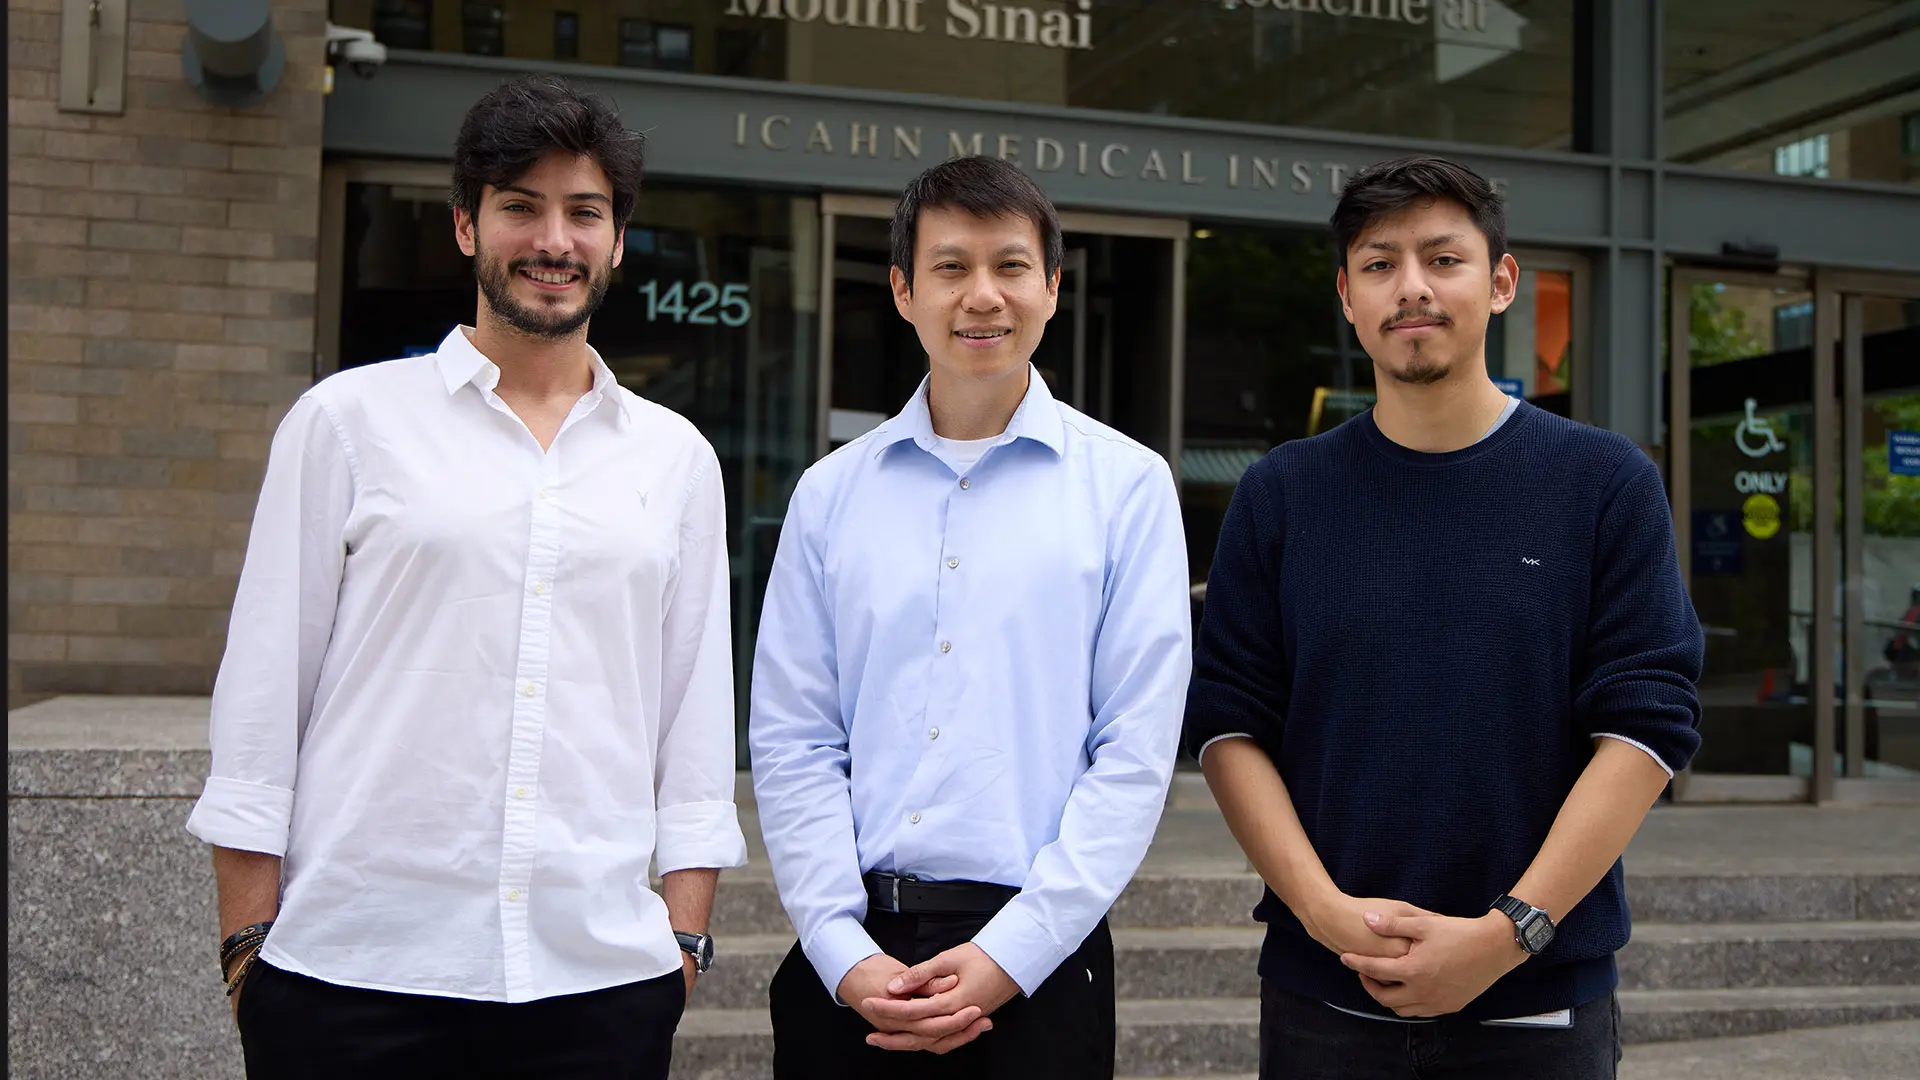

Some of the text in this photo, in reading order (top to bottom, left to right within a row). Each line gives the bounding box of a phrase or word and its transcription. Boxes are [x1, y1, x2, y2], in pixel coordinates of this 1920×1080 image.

[945, 0, 1096, 50] Sinai
[734, 112, 1510, 212] ICAHN MEDICAL INSTE
[638, 279, 751, 328] 1425
[1734, 470, 1788, 494] ONLY
